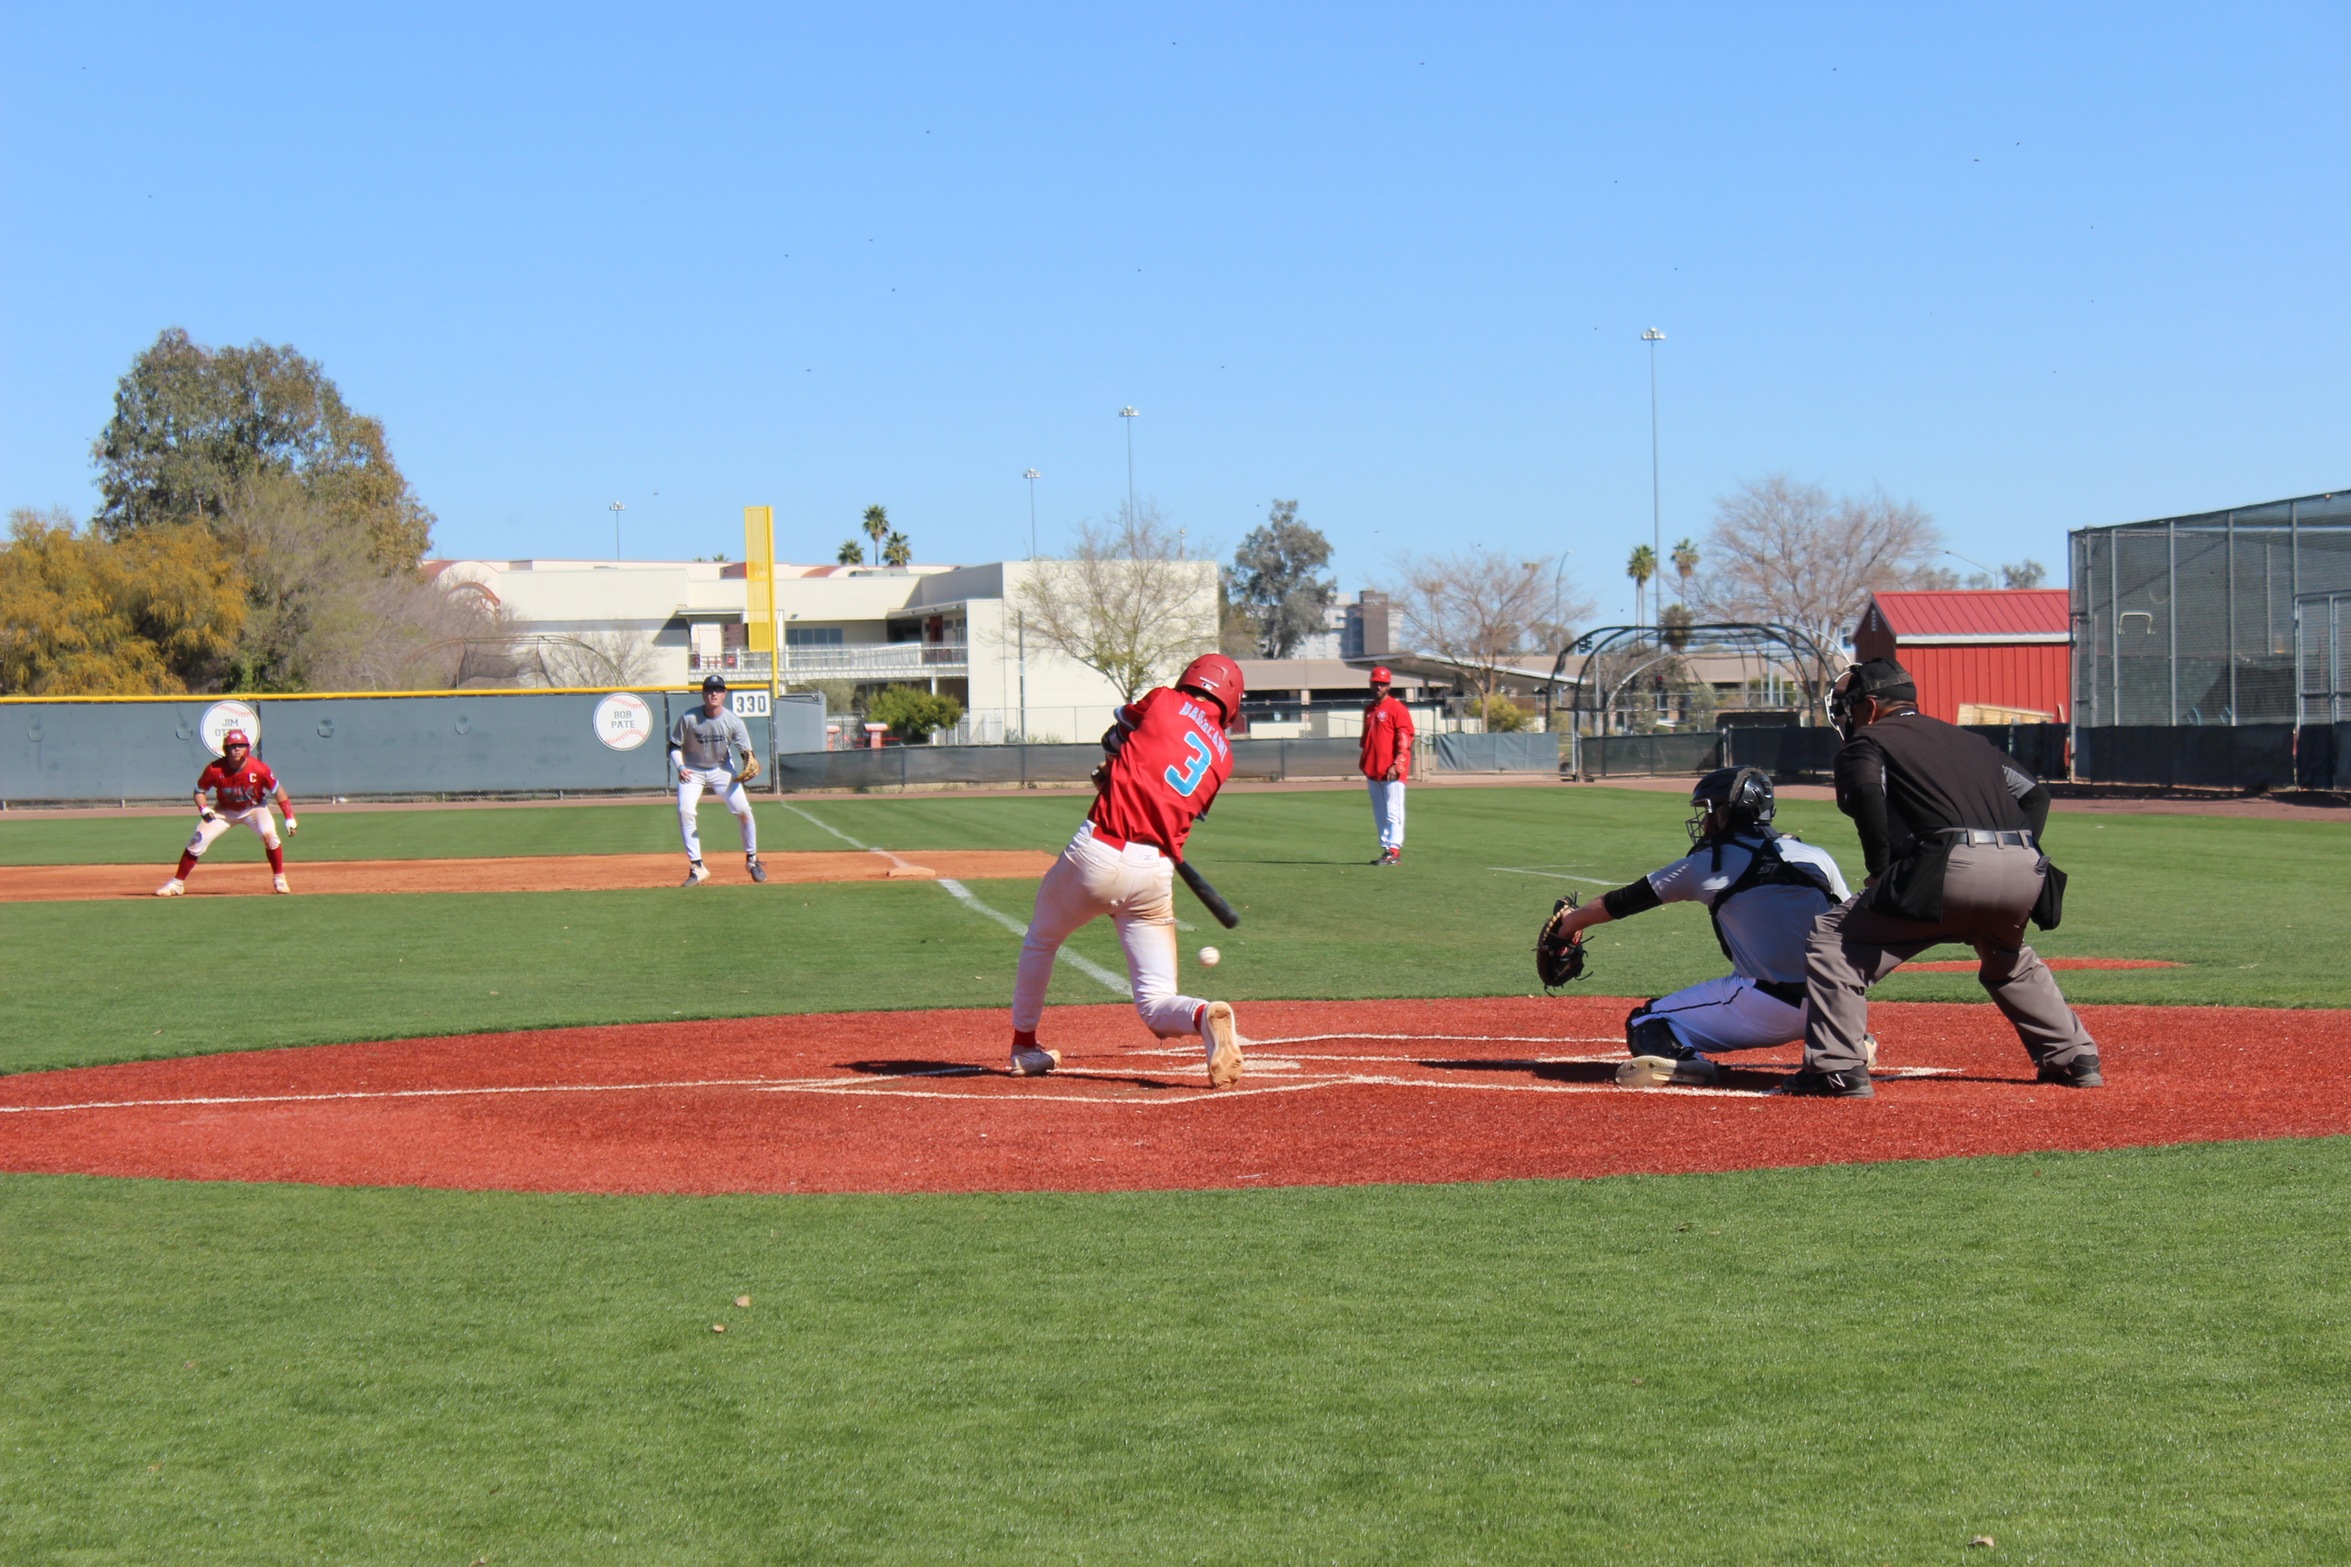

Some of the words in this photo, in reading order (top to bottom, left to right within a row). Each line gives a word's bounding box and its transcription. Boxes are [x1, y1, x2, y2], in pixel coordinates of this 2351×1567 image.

[736, 695, 766, 713] 330
[613, 710, 632, 719] BOB
[222, 718, 239, 727] JIM
[611, 720, 635, 729] PATE
[1164, 730, 1212, 797] 3
[249, 772, 257, 783] C
[1826, 1073, 1846, 1089] N
